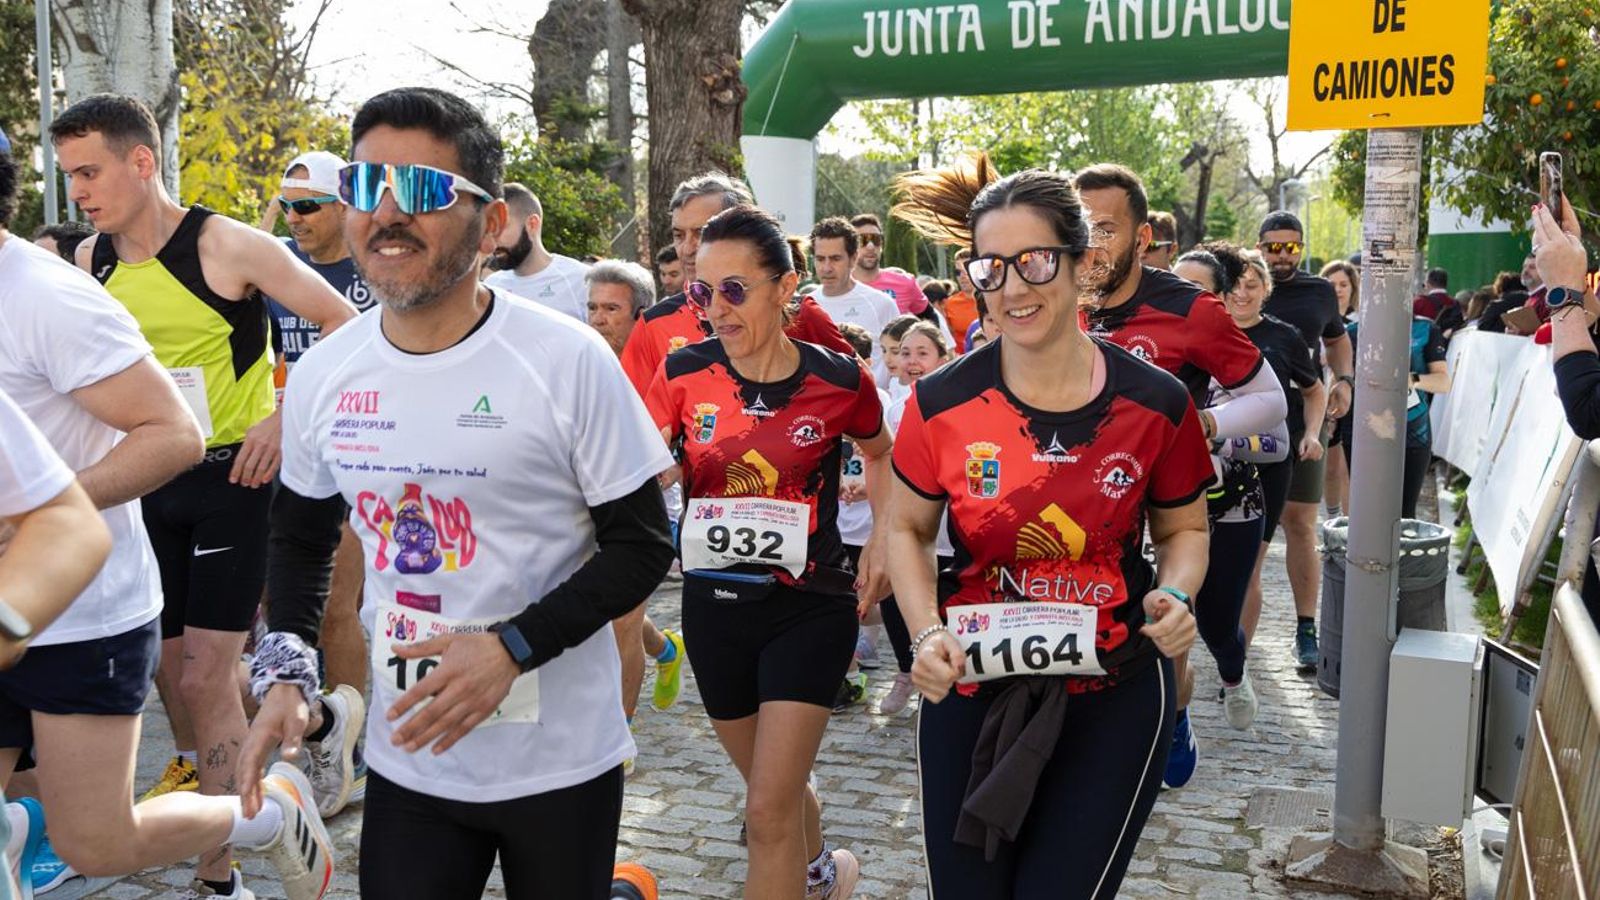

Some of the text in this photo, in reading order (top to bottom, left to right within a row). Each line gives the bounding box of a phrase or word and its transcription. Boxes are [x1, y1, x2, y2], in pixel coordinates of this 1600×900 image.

[852, 4, 986, 58] JUNTA
[1007, 0, 1061, 49] DE
[1372, 0, 1406, 34] DE
[1313, 54, 1455, 102] CAMIONES
[336, 390, 380, 414] XXVII
[360, 420, 397, 431] POPULAR
[454, 468, 463, 476] tu
[466, 468, 487, 478] salud
[1032, 453, 1079, 464] Vulkano
[706, 524, 785, 561] 932
[1000, 566, 1114, 605] Native
[964, 633, 1084, 676] 1164
